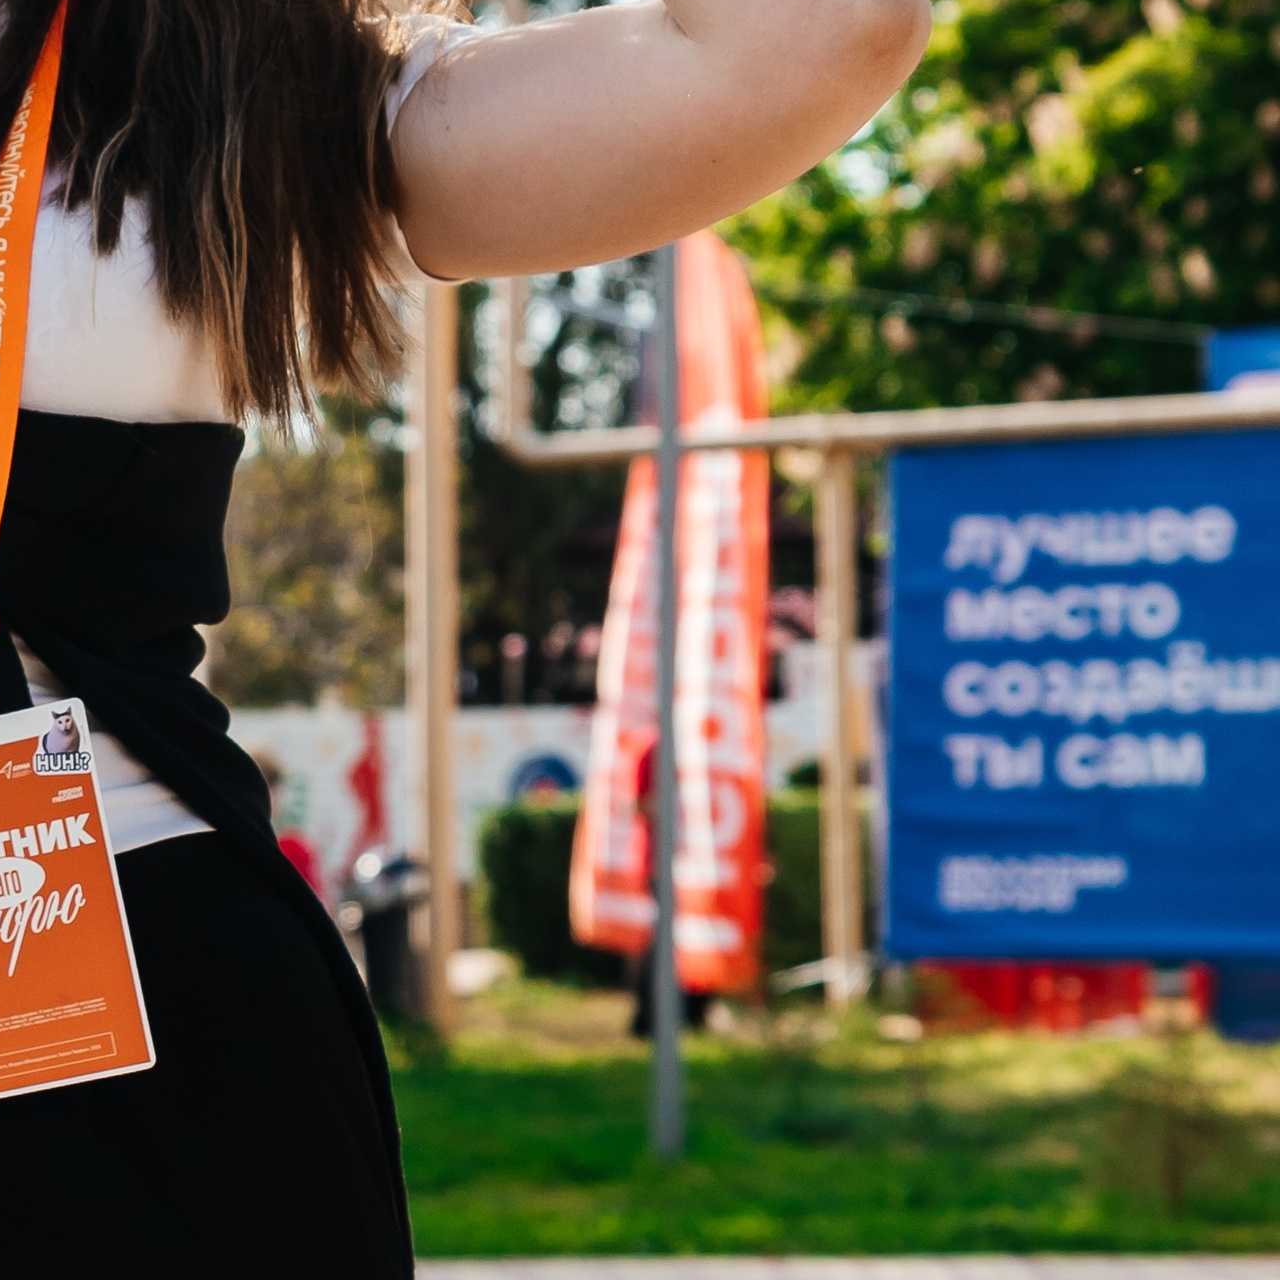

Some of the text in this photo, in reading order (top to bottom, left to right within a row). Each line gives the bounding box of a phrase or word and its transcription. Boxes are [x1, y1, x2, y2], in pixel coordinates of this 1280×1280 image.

[943, 505, 1238, 584] лучшее
[943, 582, 1180, 642] место
[35, 751, 92, 772] HUH!?
[942, 731, 1206, 789] ты сам
